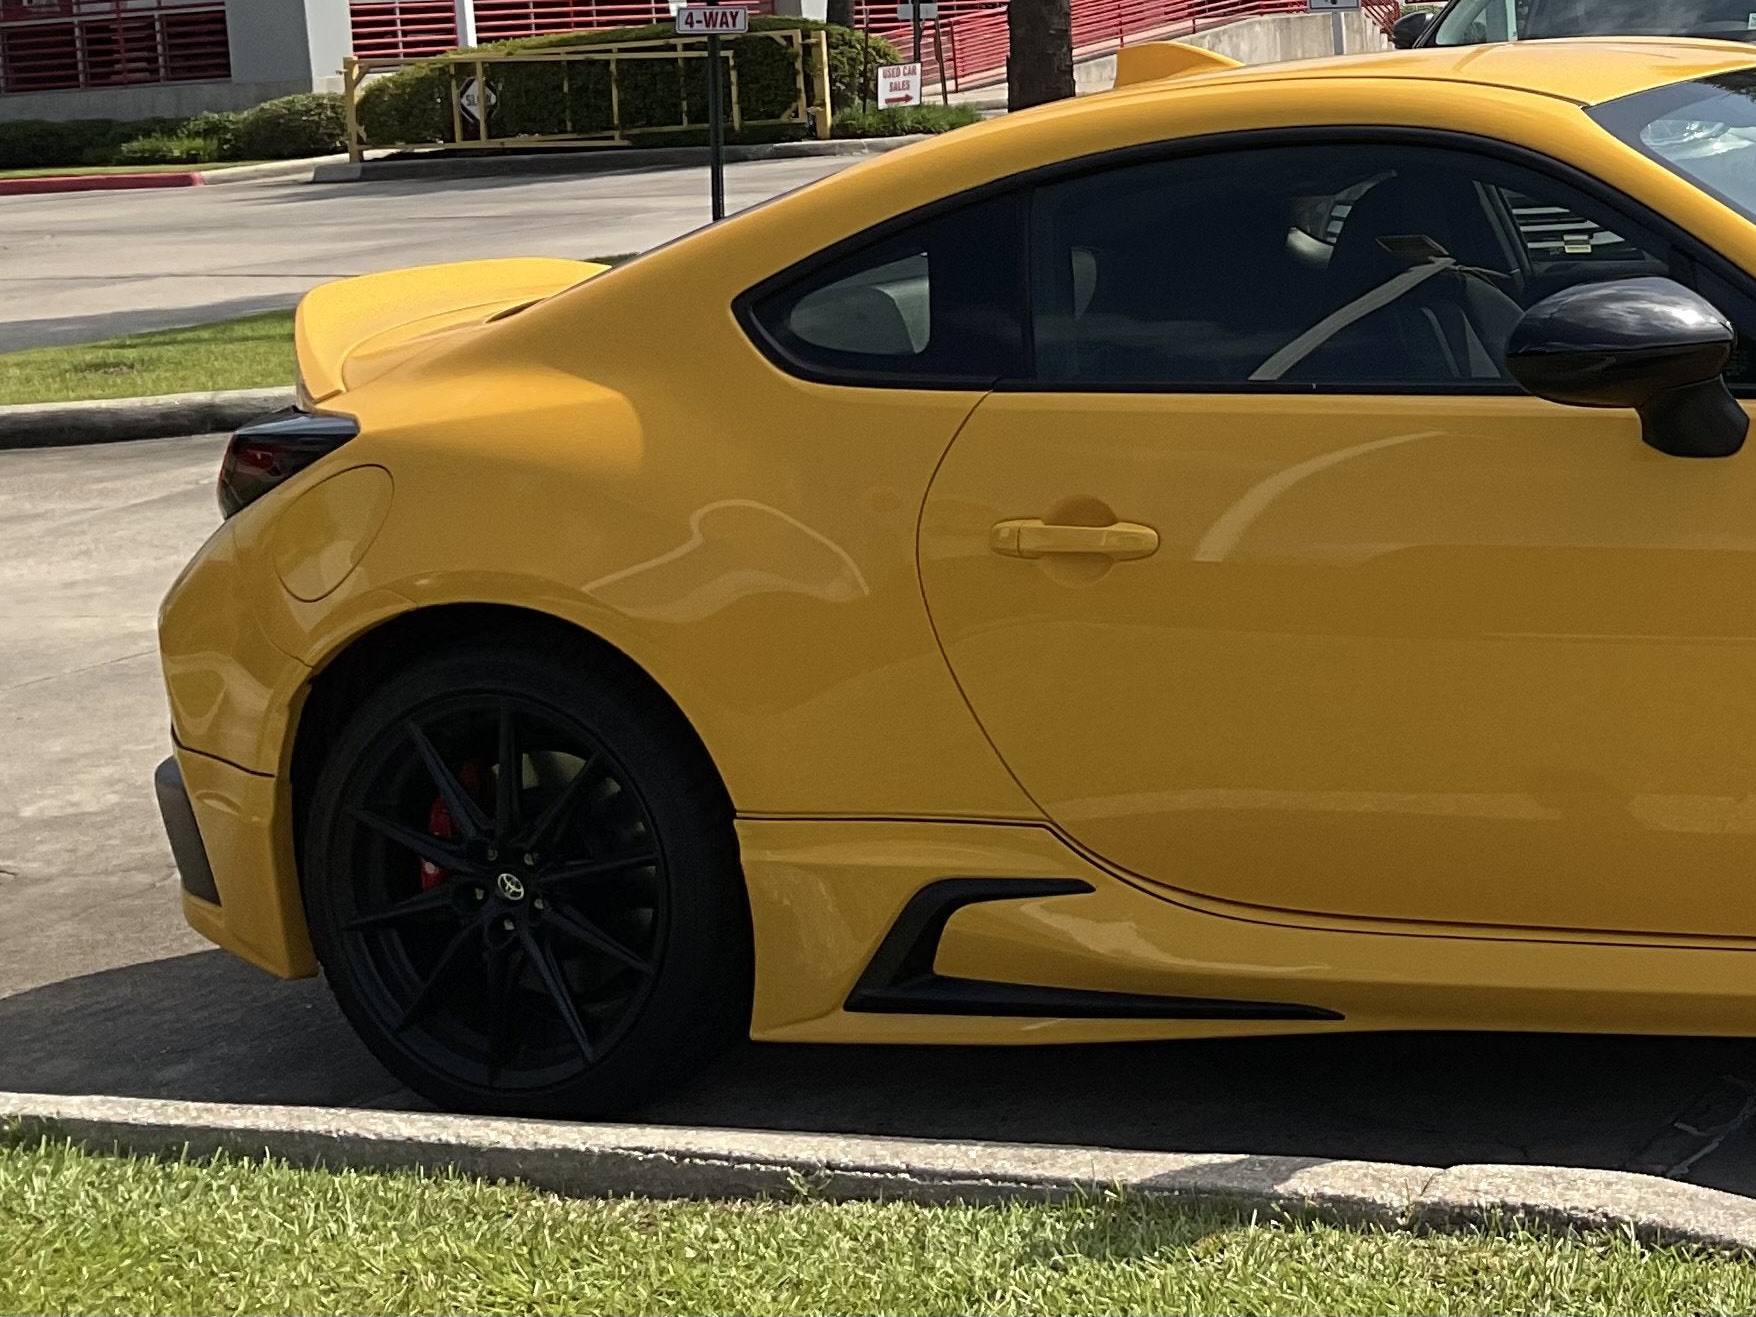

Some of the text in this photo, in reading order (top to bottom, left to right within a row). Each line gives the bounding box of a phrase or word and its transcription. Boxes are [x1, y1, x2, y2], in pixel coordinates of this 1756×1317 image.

[685, 11, 740, 28] 4-WAY
[883, 65, 917, 79] USED CAR
[889, 80, 910, 92] SALES
